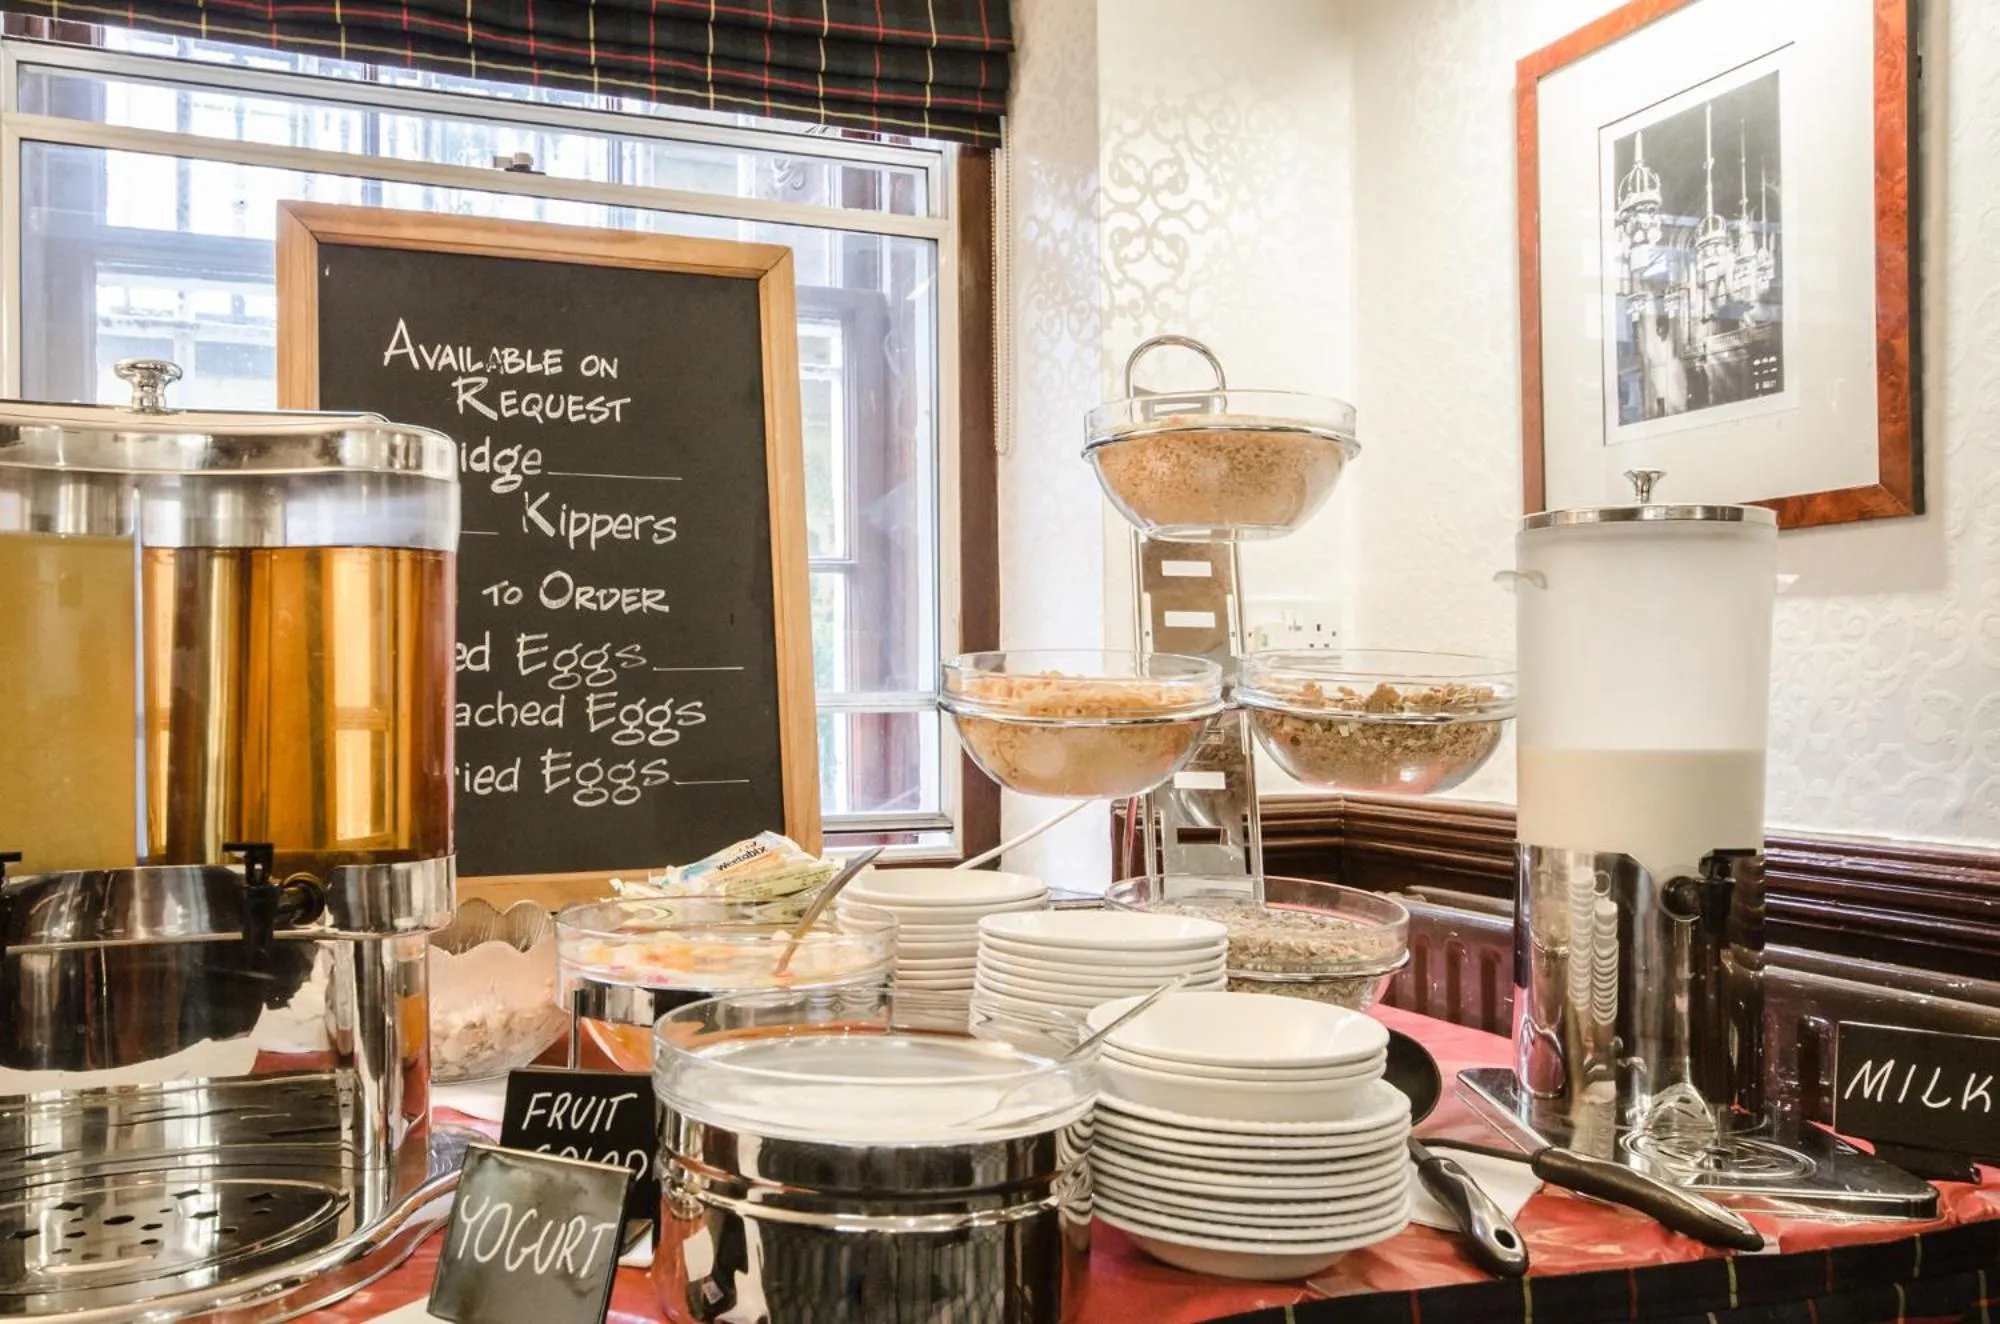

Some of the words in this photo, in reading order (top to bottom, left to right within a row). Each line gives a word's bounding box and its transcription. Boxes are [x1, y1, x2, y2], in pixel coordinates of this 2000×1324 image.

[384, 318, 563, 376] AVAILABLE
[580, 355, 618, 379] ON
[451, 376, 631, 424] REQUEST
[522, 491, 677, 550] Kippers
[481, 580, 523, 607] TO
[539, 570, 670, 614] ORDER
[516, 632, 647, 690] Eggs
[586, 691, 706, 746] Eggs
[455, 756, 521, 795] ied
[540, 748, 670, 807] Eggs
[522, 1092, 638, 1133] FRUIT
[1844, 1059, 1993, 1113] MILK
[457, 1194, 617, 1278] YOGURT
